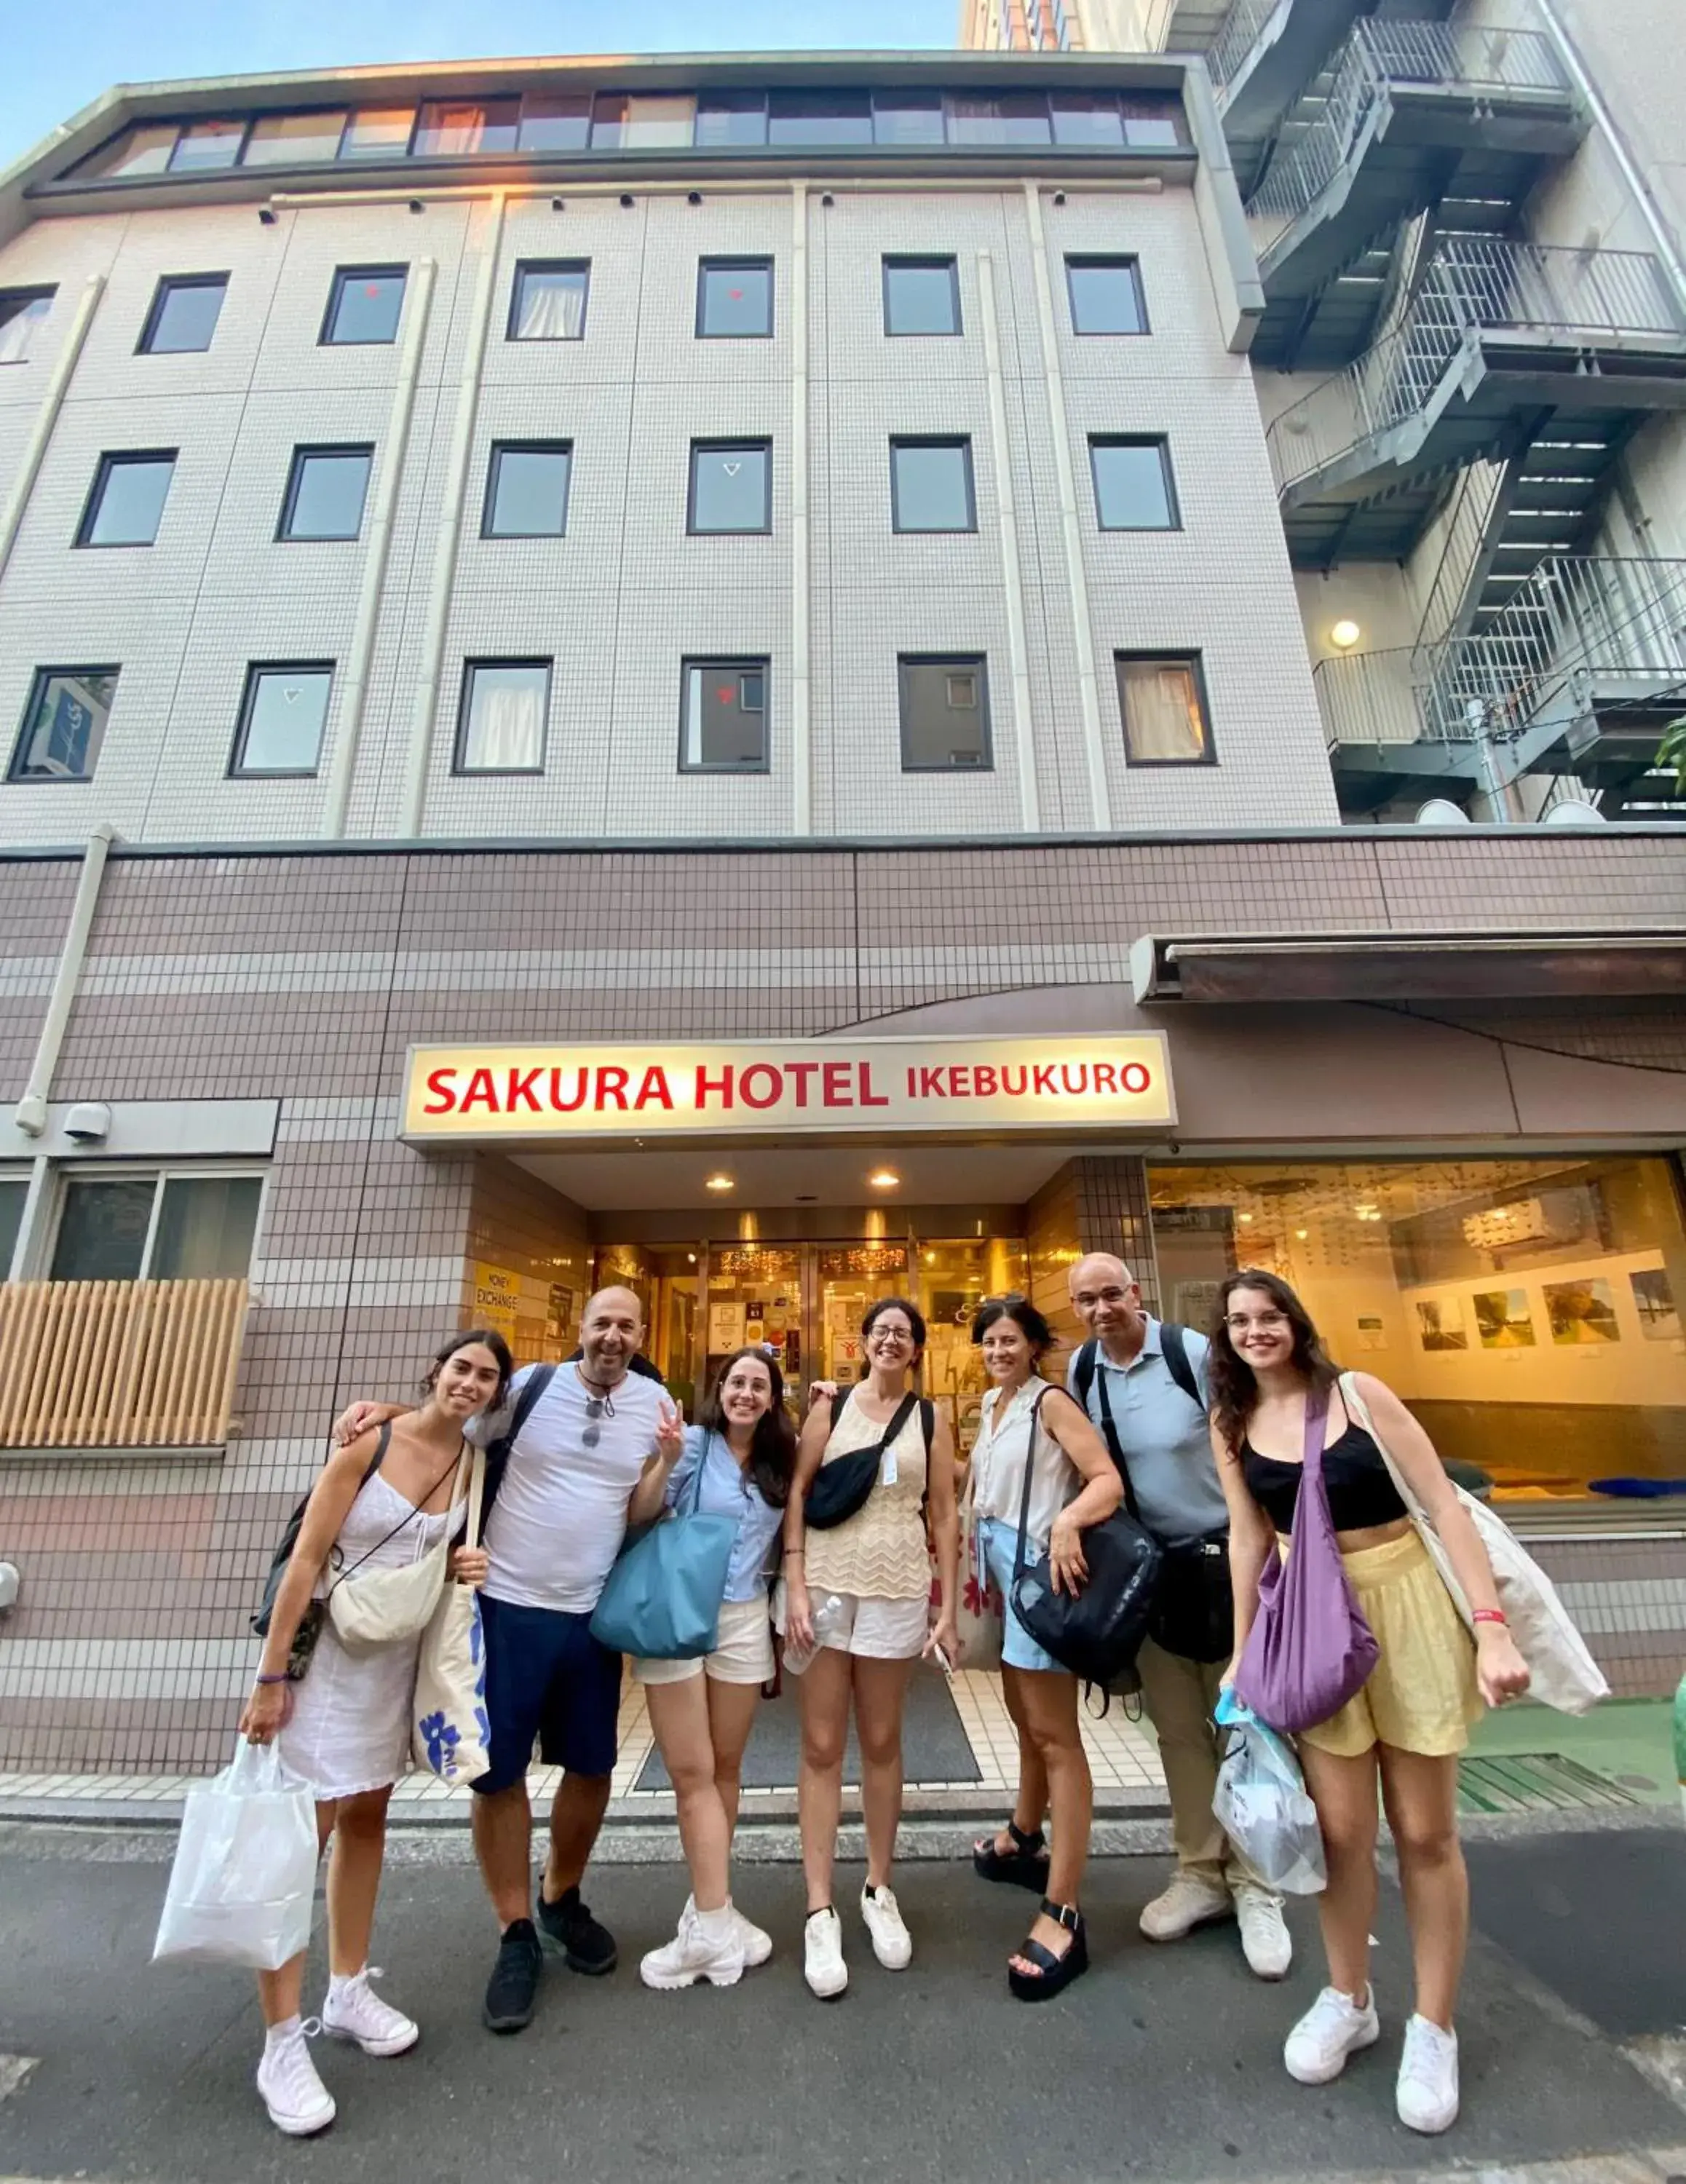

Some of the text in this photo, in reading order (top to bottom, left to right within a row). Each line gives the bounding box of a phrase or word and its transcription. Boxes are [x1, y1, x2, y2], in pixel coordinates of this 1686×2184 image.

[423, 1062, 1152, 1115] SAKURA HOTEL IKEBUKURO
[488, 1273, 510, 1289] MONEY
[477, 1287, 518, 1310] EXCHANGE
